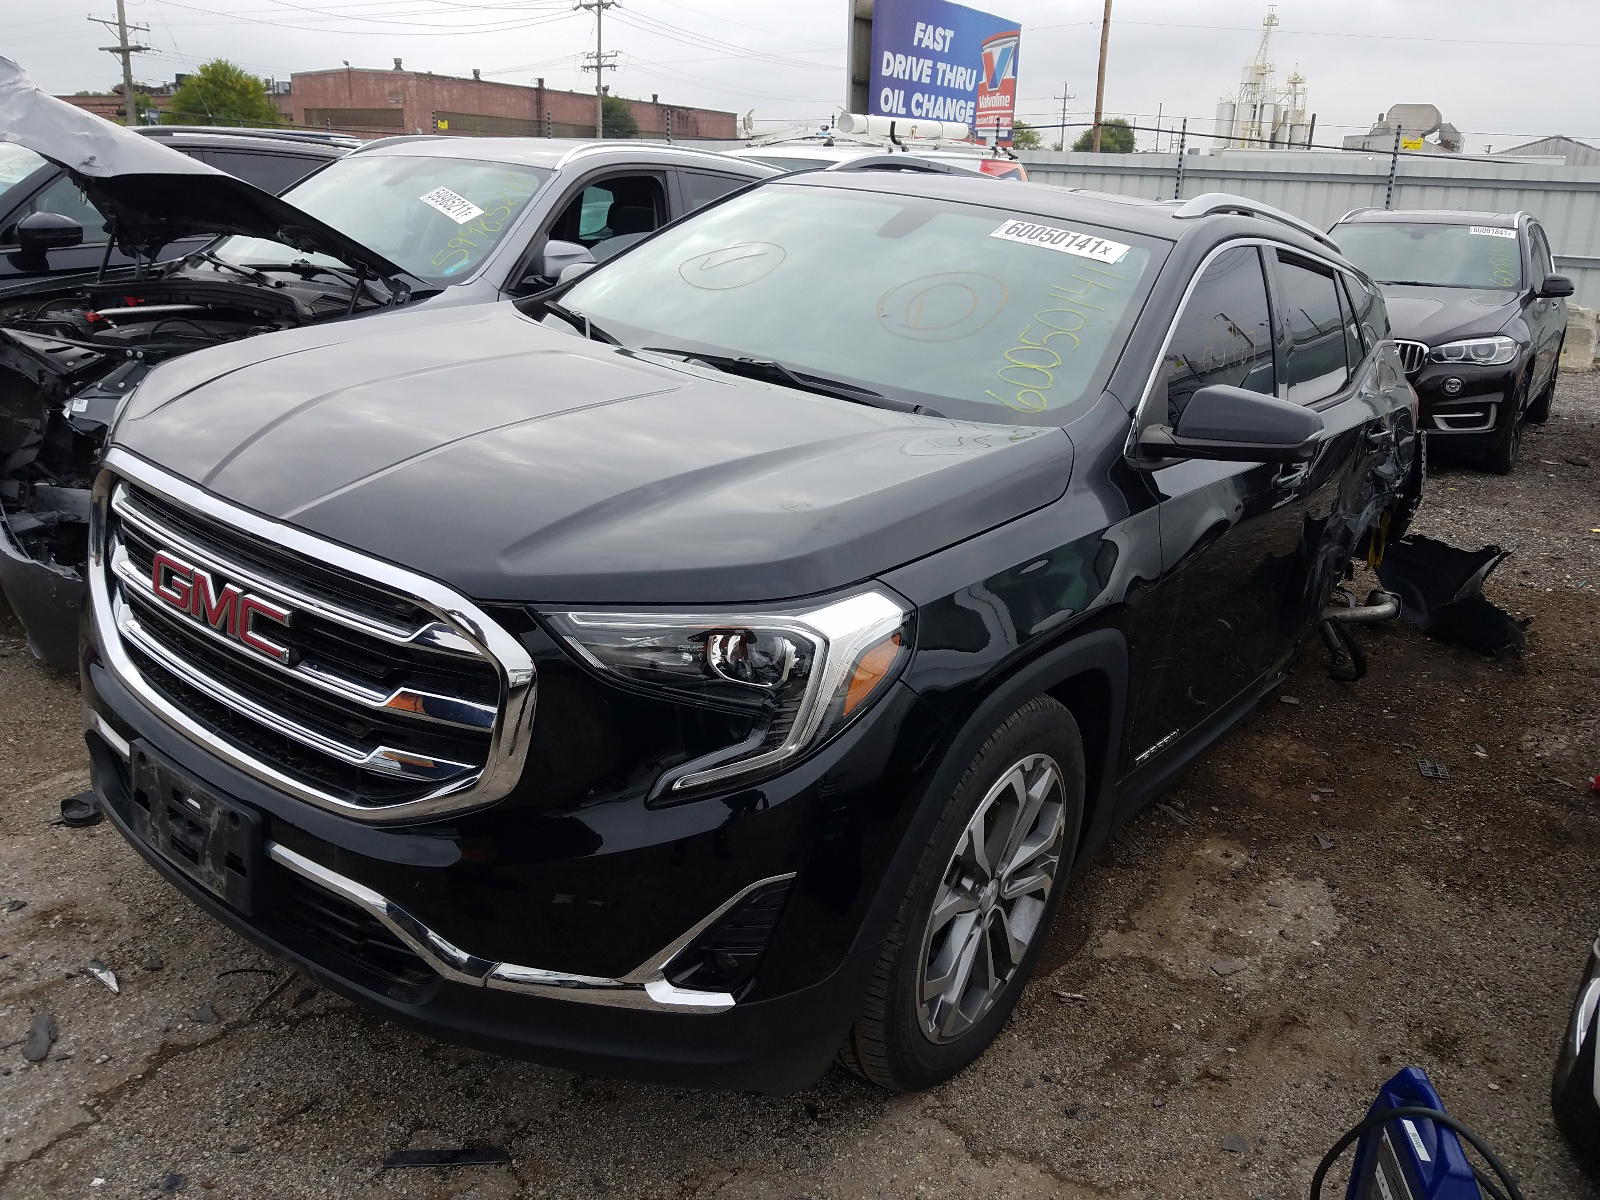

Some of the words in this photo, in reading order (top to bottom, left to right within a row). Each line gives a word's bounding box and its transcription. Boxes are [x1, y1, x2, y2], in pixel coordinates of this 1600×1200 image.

[913, 22, 954, 52] FAST
[881, 51, 933, 84] DRIVE
[936, 62, 977, 92] THRU
[880, 87, 907, 115] OIL
[911, 92, 975, 124] CHANGE
[979, 92, 1011, 109] Valvoline
[994, 115, 1011, 126] Cange
[985, 264, 1129, 413] 60050141
[153, 550, 293, 665] GMC
